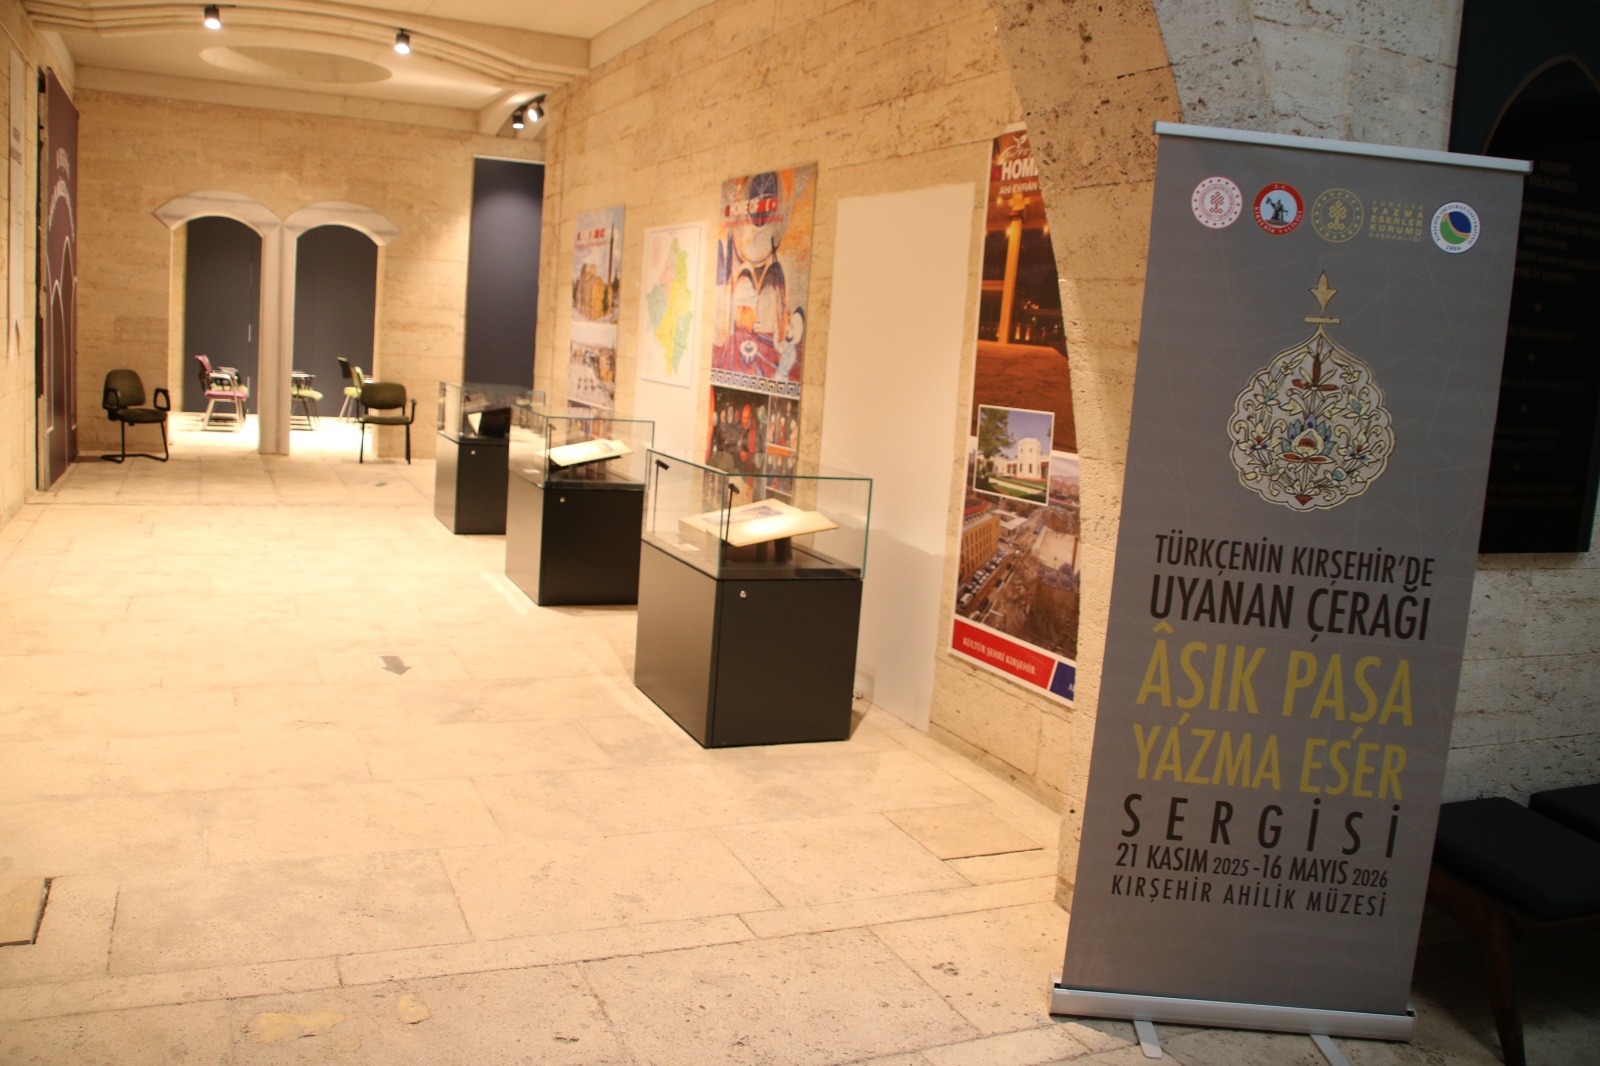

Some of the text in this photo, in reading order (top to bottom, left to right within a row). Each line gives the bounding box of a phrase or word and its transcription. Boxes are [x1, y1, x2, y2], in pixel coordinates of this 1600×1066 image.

[1370, 223, 1422, 236] KURUMU
[1371, 214, 1423, 227] ESERLER
[1372, 206, 1424, 219] YAZMA
[1155, 529, 1284, 576] TÜRKÇENİN
[1150, 574, 1431, 643] UYANAN ÇERAĞI
[1136, 620, 1413, 741] ÂŞIK PAŞA
[1132, 723, 1408, 800] YAZMA ESER
[1121, 793, 1401, 859] SERGİSİ
[1116, 843, 1138, 867] 21
[1146, 845, 1208, 873] KASIM
[1289, 857, 1348, 884] MAYIS
[1353, 868, 1388, 888] 2026
[1111, 874, 1387, 917] KIRŞEHİR AHİLİK MÜZESİ
